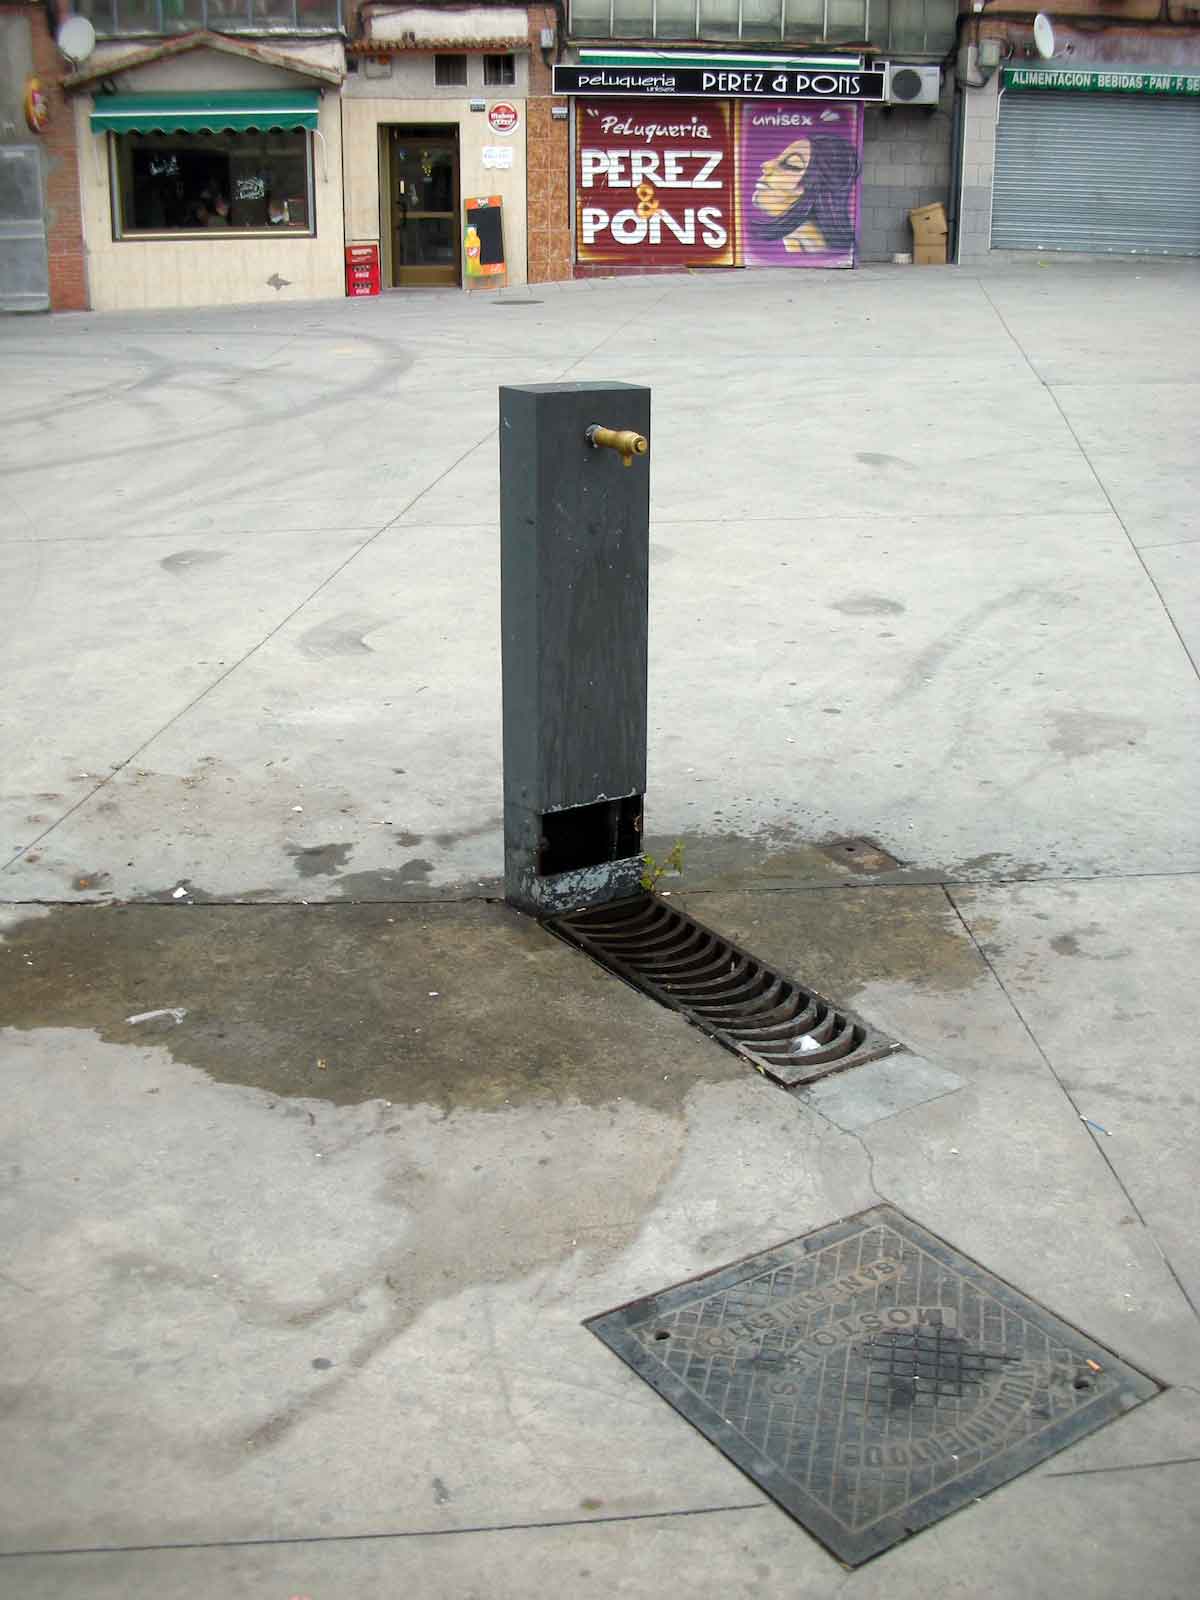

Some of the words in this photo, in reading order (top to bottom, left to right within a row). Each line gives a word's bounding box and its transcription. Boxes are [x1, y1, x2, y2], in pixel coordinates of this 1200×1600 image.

[578, 72, 675, 87] peluqueria
[703, 72, 763, 92] PEREZ
[772, 74, 787, 92] &
[797, 76, 861, 94] PONS
[1012, 71, 1091, 87] ALIMENTACION
[1098, 75, 1143, 88] BEBIDAS
[1150, 78, 1170, 90] PAN
[581, 150, 723, 188] PEREZ
[582, 207, 728, 249] PONS
